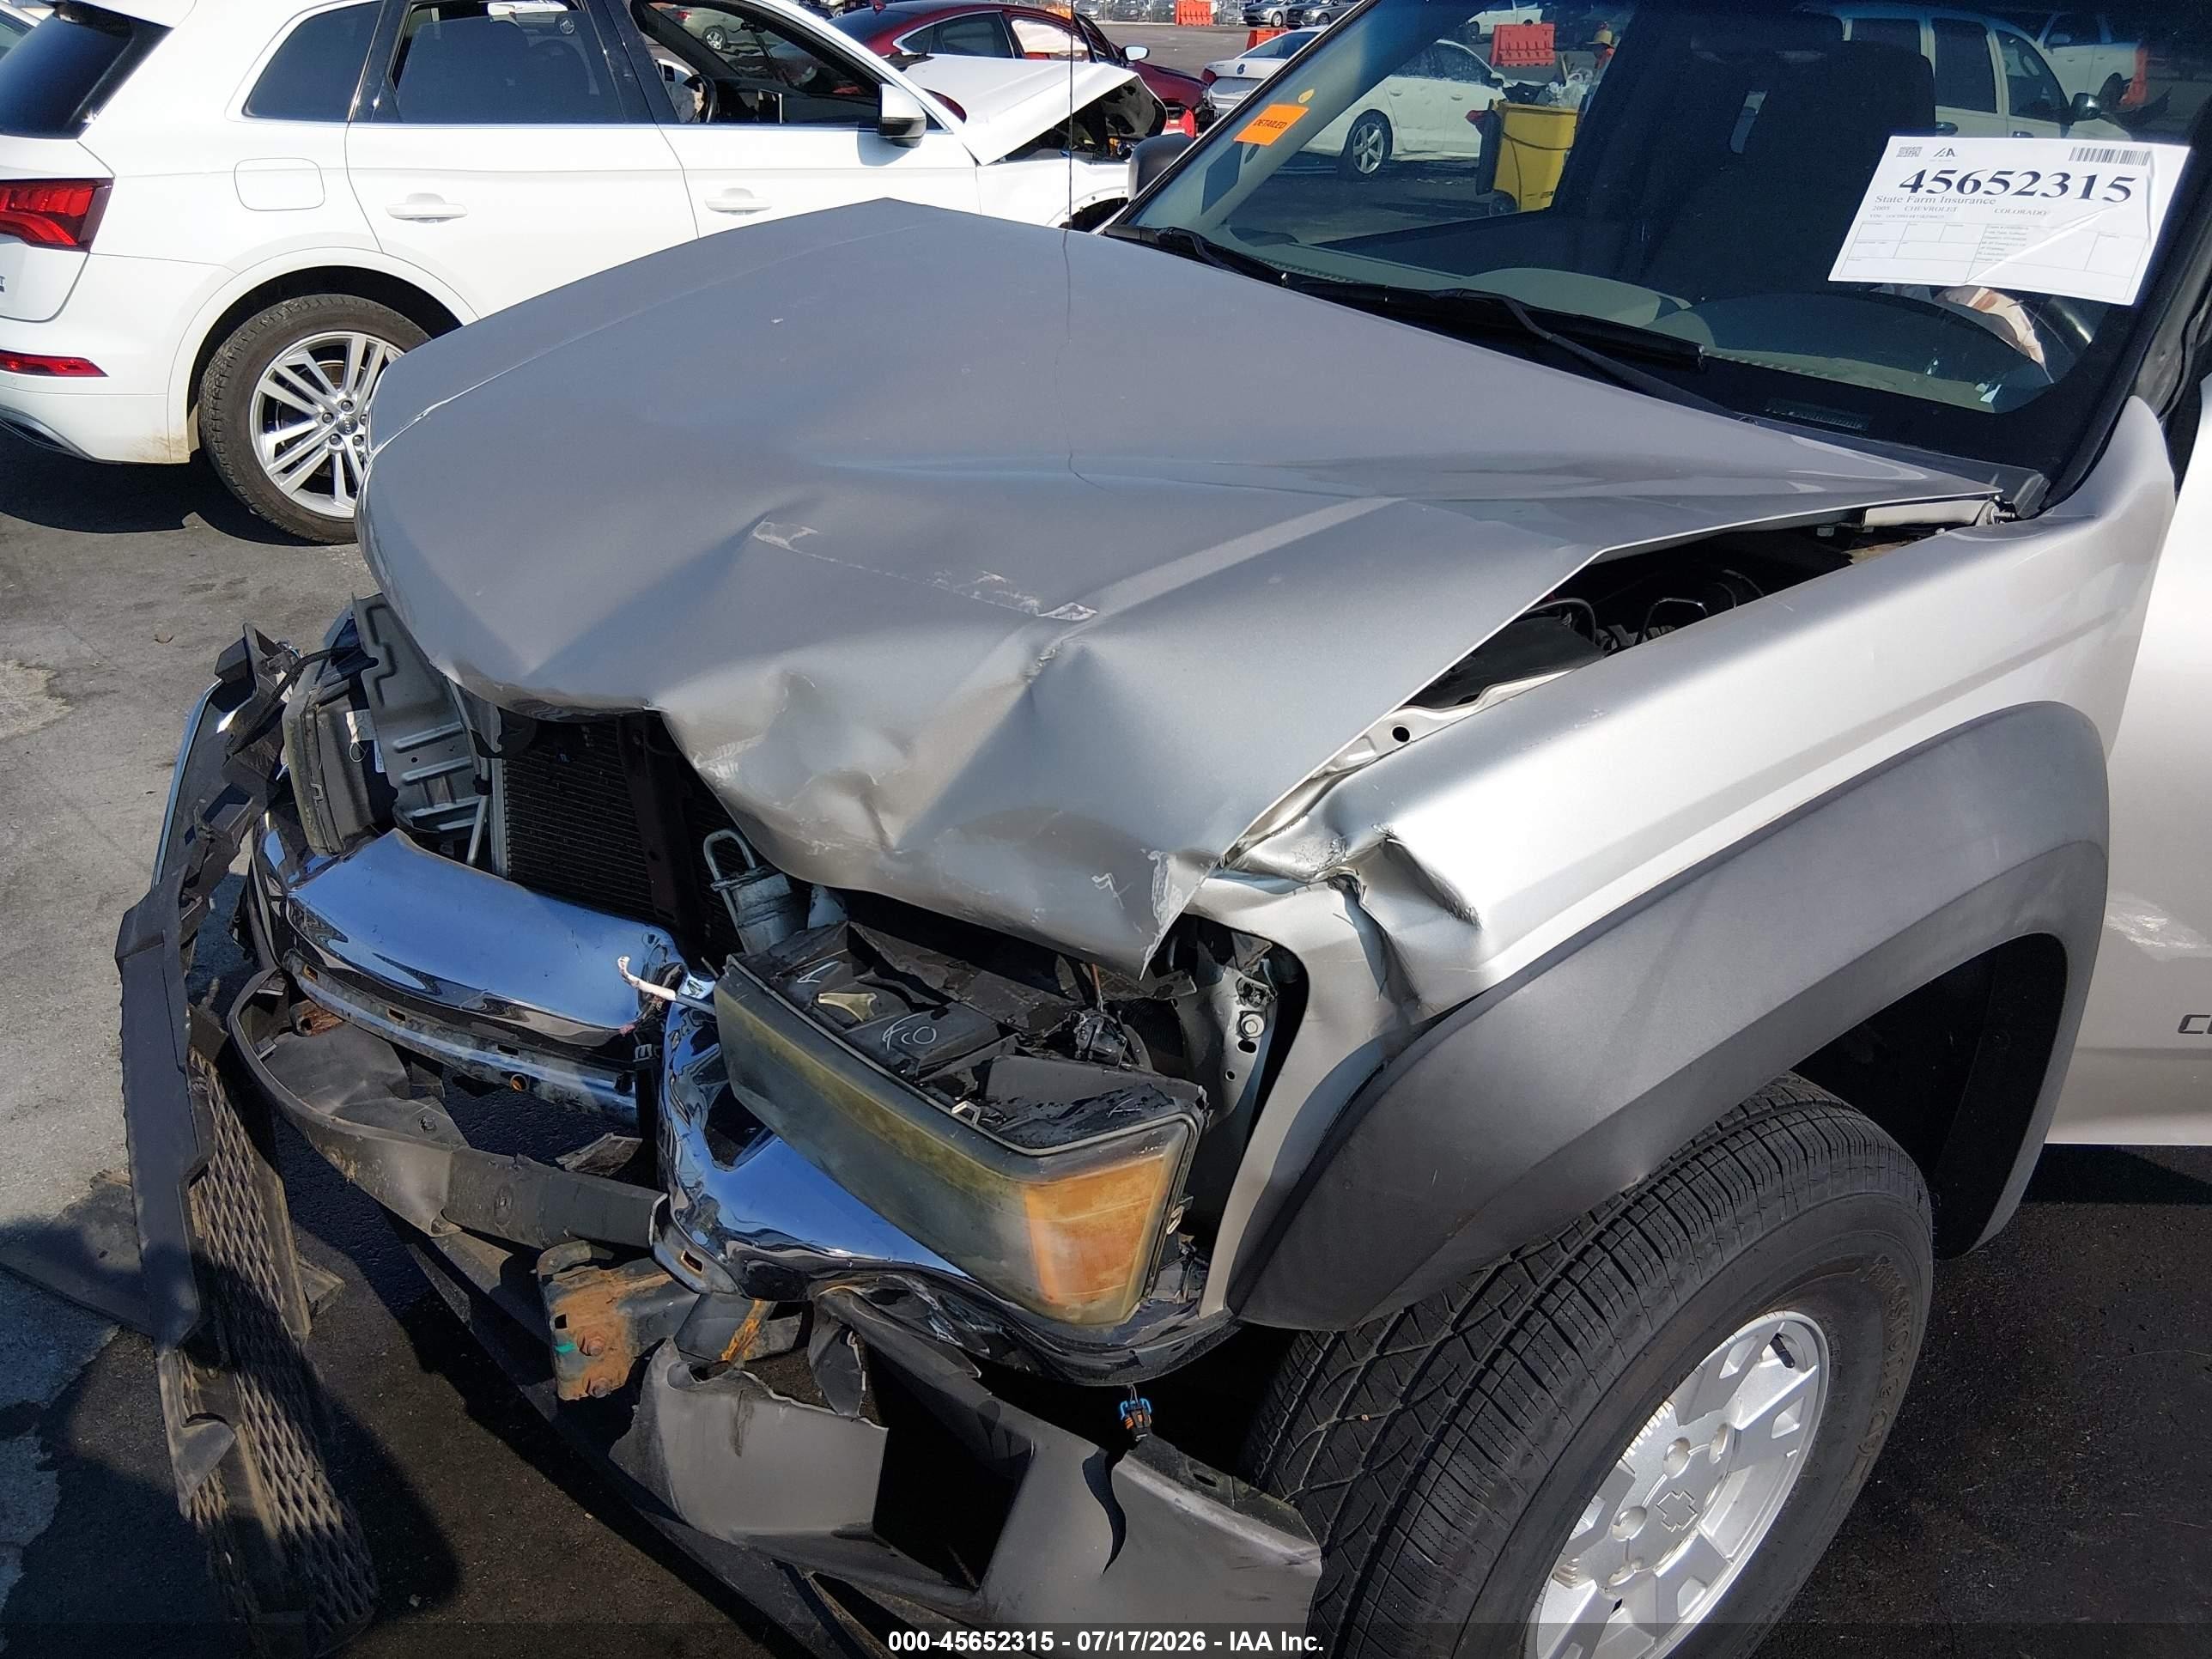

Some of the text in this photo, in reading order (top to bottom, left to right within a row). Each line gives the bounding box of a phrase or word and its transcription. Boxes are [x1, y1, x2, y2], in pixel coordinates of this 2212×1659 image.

[1253, 118, 1288, 130] DETAILED
[1899, 168, 2137, 203] 45652315
[1875, 195, 1996, 205] State Farm Insurance
[1994, 208, 2047, 216] COLORADO
[2177, 1014, 2212, 1035] C
